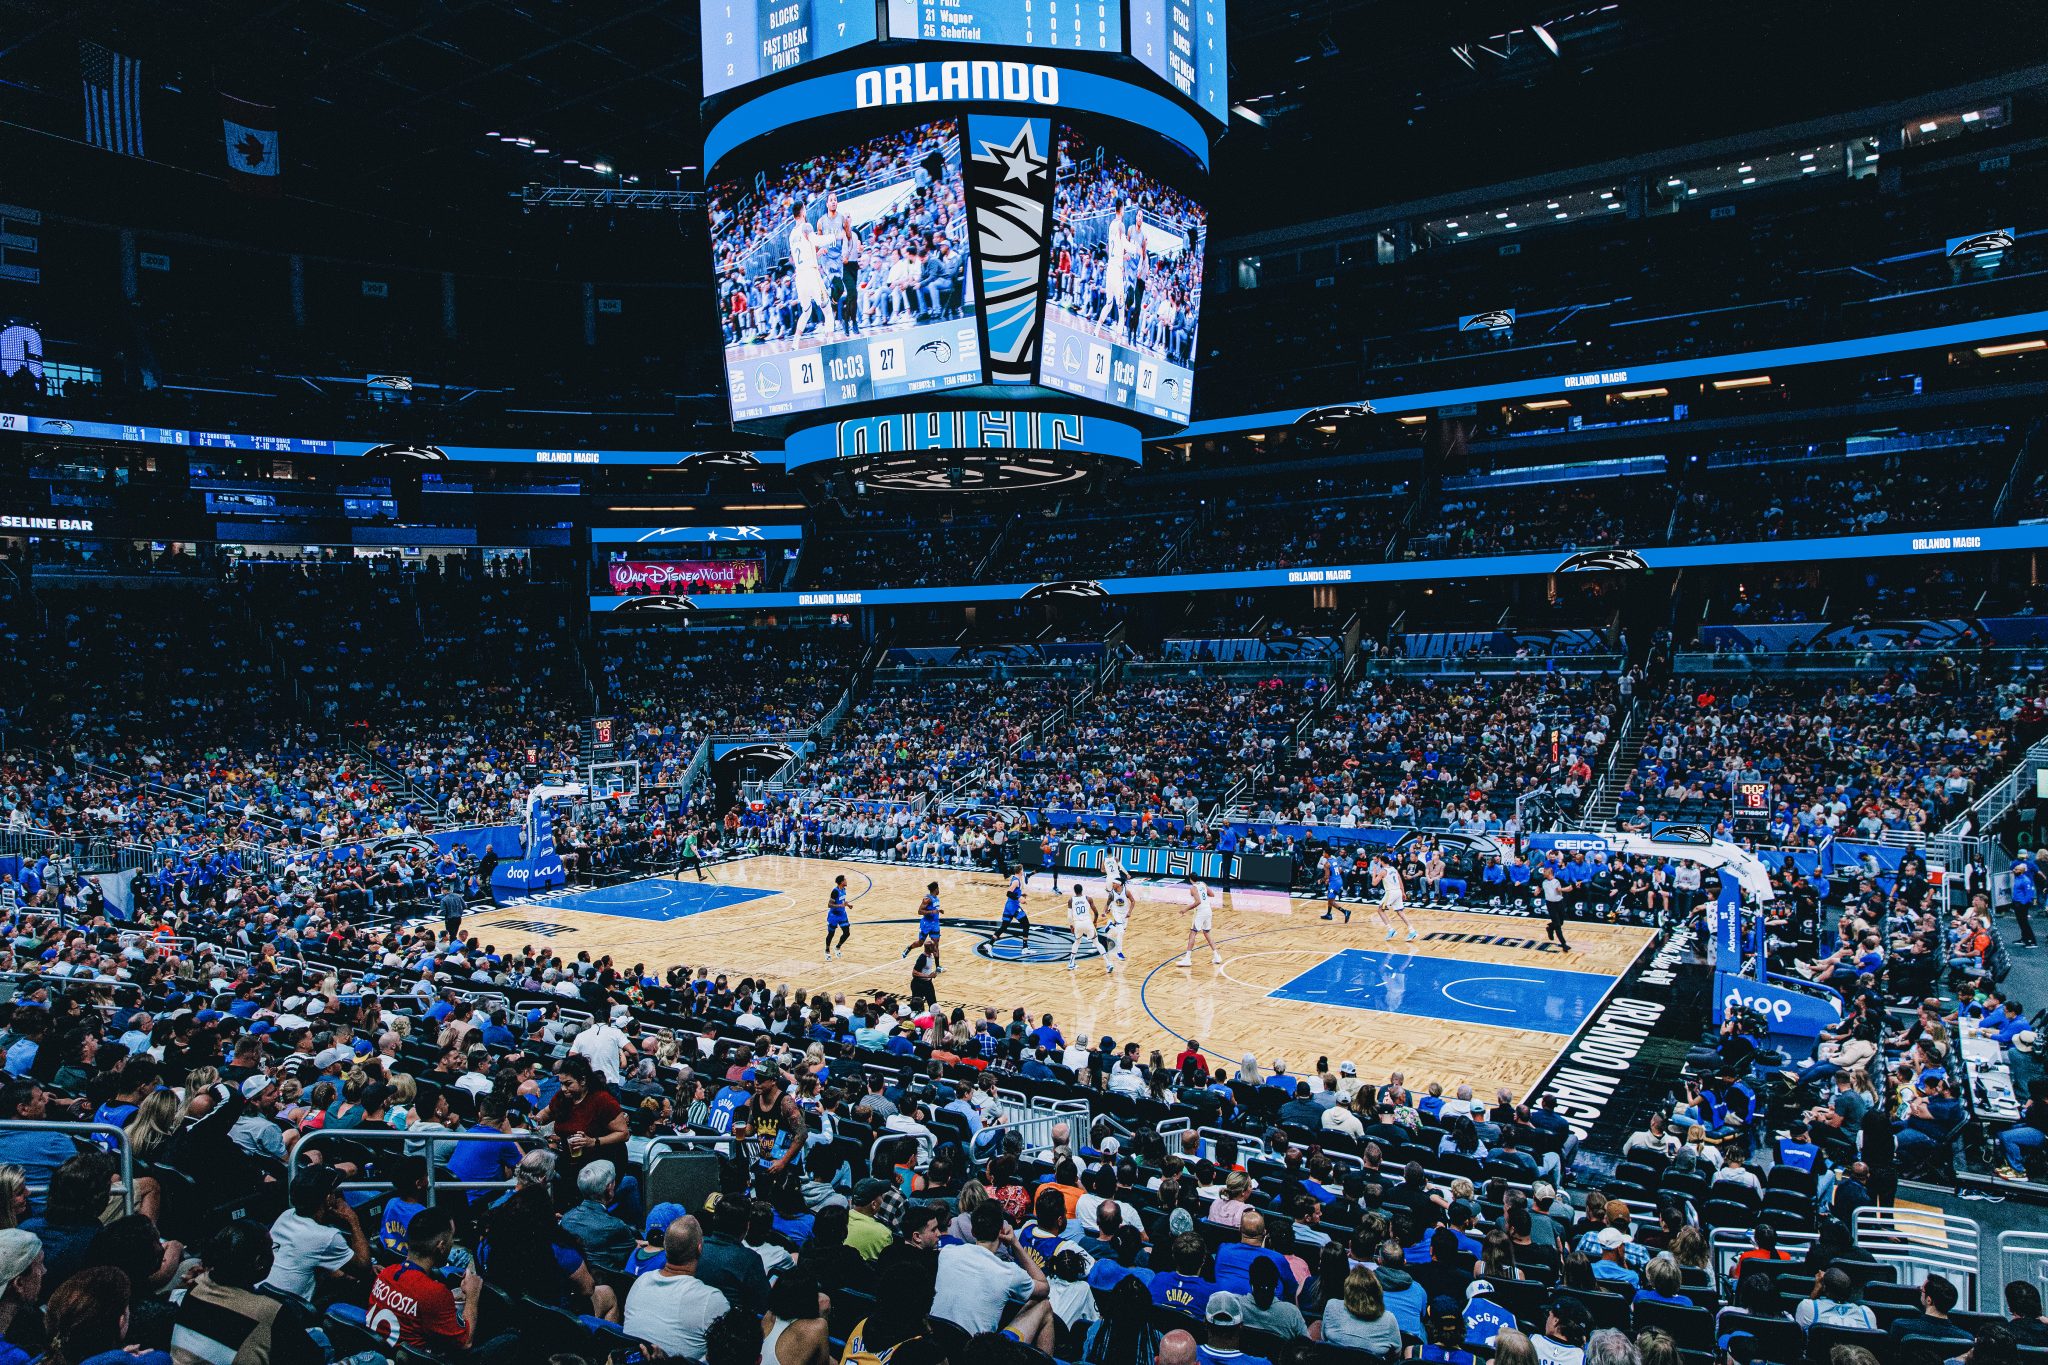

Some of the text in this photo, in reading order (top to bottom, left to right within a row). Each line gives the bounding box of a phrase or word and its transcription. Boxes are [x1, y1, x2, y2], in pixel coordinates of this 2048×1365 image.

[725, 6, 731, 18] 1
[769, 4, 799, 29] BLOCKS
[925, 9, 973, 25] 21 Wagner
[1145, 11, 1151, 25] 2
[1173, 6, 1190, 32] STEALS
[837, 23, 846, 37] 7
[1027, 16, 1032, 28] 1
[1075, 19, 1081, 32] 0
[725, 32, 733, 45] 2
[923, 25, 981, 41] 25 Schofield
[1026, 31, 1033, 44] 0
[1075, 34, 1081, 47] 2
[763, 27, 808, 57] FAST BREAK
[1146, 43, 1152, 56] 2
[1173, 30, 1191, 56] BLOCKS
[772, 49, 800, 71] POINTS
[1169, 50, 1196, 83] FAST BREAK
[727, 63, 734, 76] 2
[855, 60, 1059, 109] ORLANDO
[1174, 70, 1191, 96] POINTS
[956, 328, 978, 362] ORL
[1043, 328, 1056, 367] GSW
[879, 347, 894, 371] 27
[1096, 353, 1104, 374] 21
[801, 363, 813, 384] 21
[828, 354, 865, 382] 10:03
[1113, 359, 1135, 387] 10:03
[729, 369, 747, 402] GSW
[1143, 368, 1152, 389] 27
[1564, 371, 1627, 388] ORLANDO MAGIC
[841, 383, 857, 399] 2ND
[2, 416, 15, 428] 27
[123, 425, 137, 433] TEAM
[122, 433, 138, 441] FOULS
[140, 428, 145, 441] 1
[160, 428, 172, 436] TIME
[175, 431, 182, 444] 6
[255, 442, 270, 450] 3-10
[275, 443, 291, 451] 30%
[536, 451, 600, 463] ORLANDO MAGIC
[0, 515, 93, 531] SELINE BAR
[1912, 536, 1981, 550] ORLANDO MAGIC
[699, 568, 735, 581] World
[1288, 569, 1352, 583] ORLANDO MAGIC
[798, 593, 862, 605] ORLANDO MAGIC
[600, 729, 610, 742] 19
[1741, 784, 1765, 795] 10:02
[1748, 794, 1761, 807] 19
[1554, 839, 1606, 851] GEICO
[507, 865, 529, 883] drop
[1076, 905, 1086, 915] 00
[1727, 901, 1736, 953] AdventHealth
[1422, 931, 1562, 954] MAGIC
[1724, 988, 1791, 1023] drop
[1569, 997, 1666, 1071] ORLANDO
[710, 1108, 730, 1134] 00
[387, 1290, 418, 1317] COSTA
[1166, 1288, 1194, 1306] CURRY
